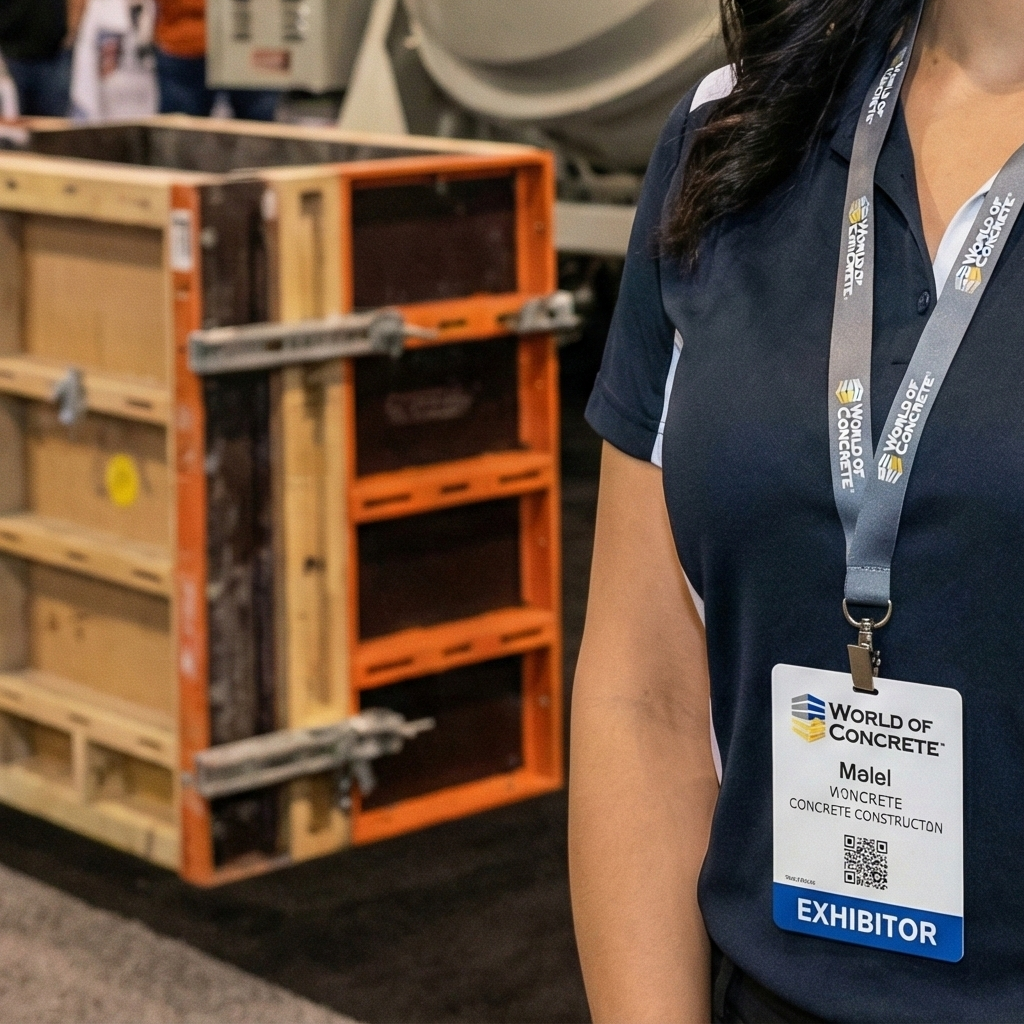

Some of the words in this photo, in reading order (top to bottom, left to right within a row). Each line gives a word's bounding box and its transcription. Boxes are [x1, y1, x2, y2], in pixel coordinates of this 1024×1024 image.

[906, 378, 919, 397] OF
[828, 702, 903, 729] WORLD
[909, 718, 933, 734] OF
[789, 798, 851, 819] CONCRETE
[797, 897, 937, 946] EXHIBITOR
